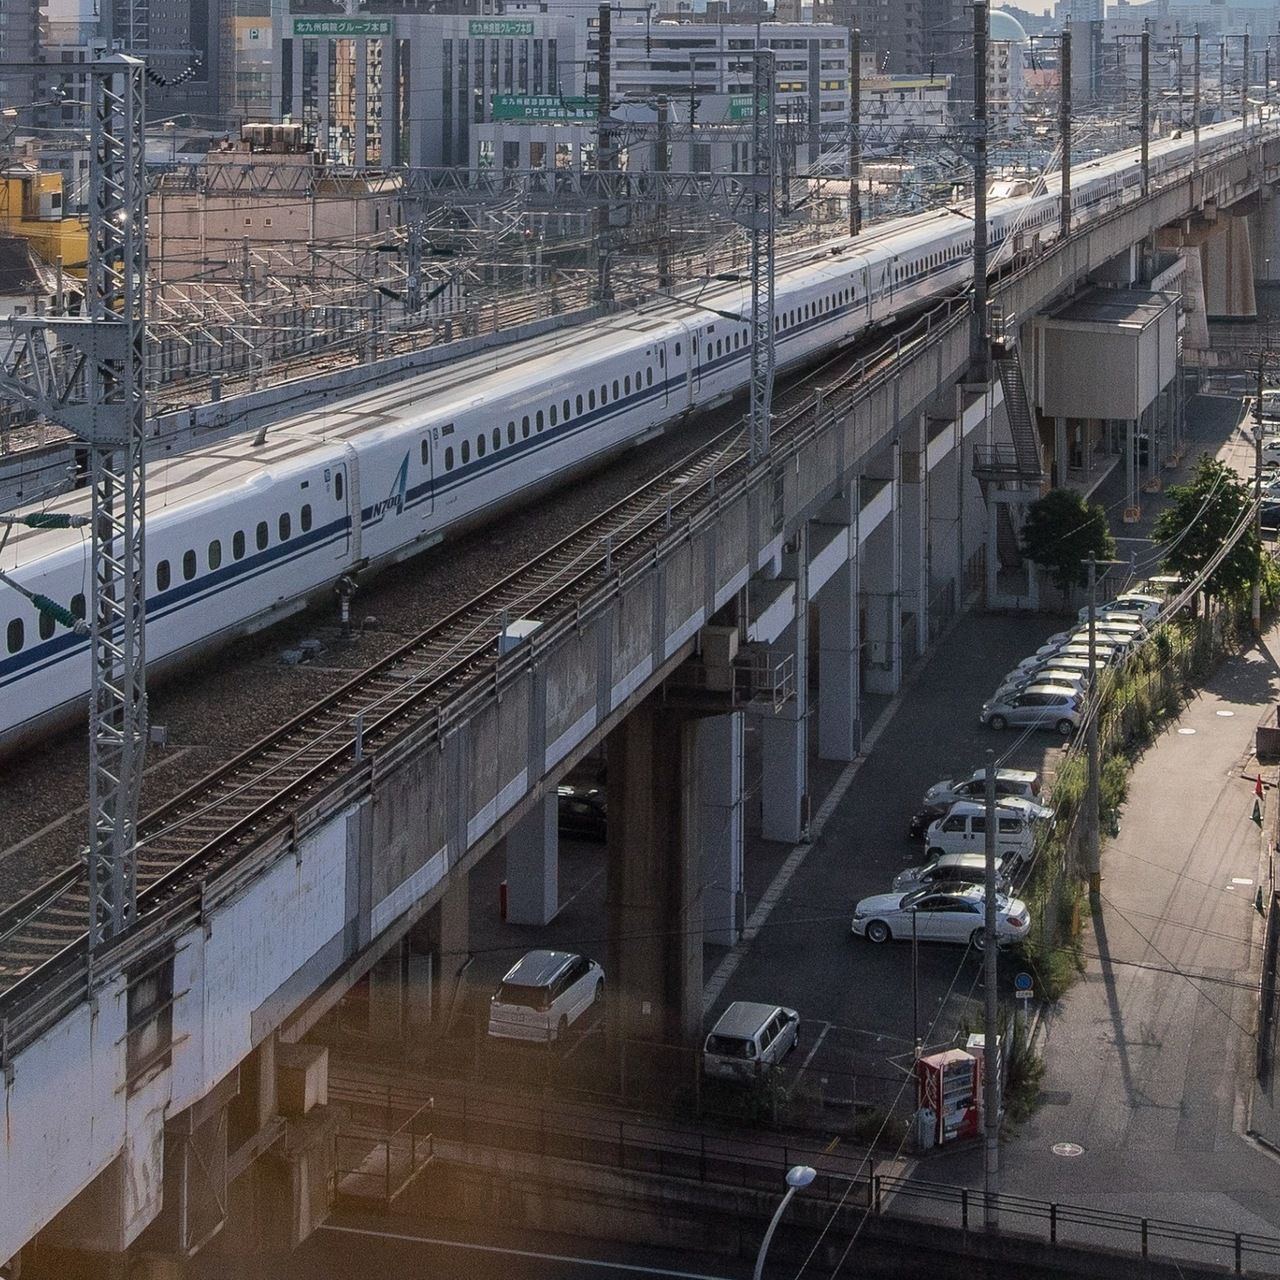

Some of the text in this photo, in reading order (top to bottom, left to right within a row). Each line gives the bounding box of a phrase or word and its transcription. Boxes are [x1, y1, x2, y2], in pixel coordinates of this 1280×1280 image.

[297, 22, 388, 32] 北九州病院グループ本部
